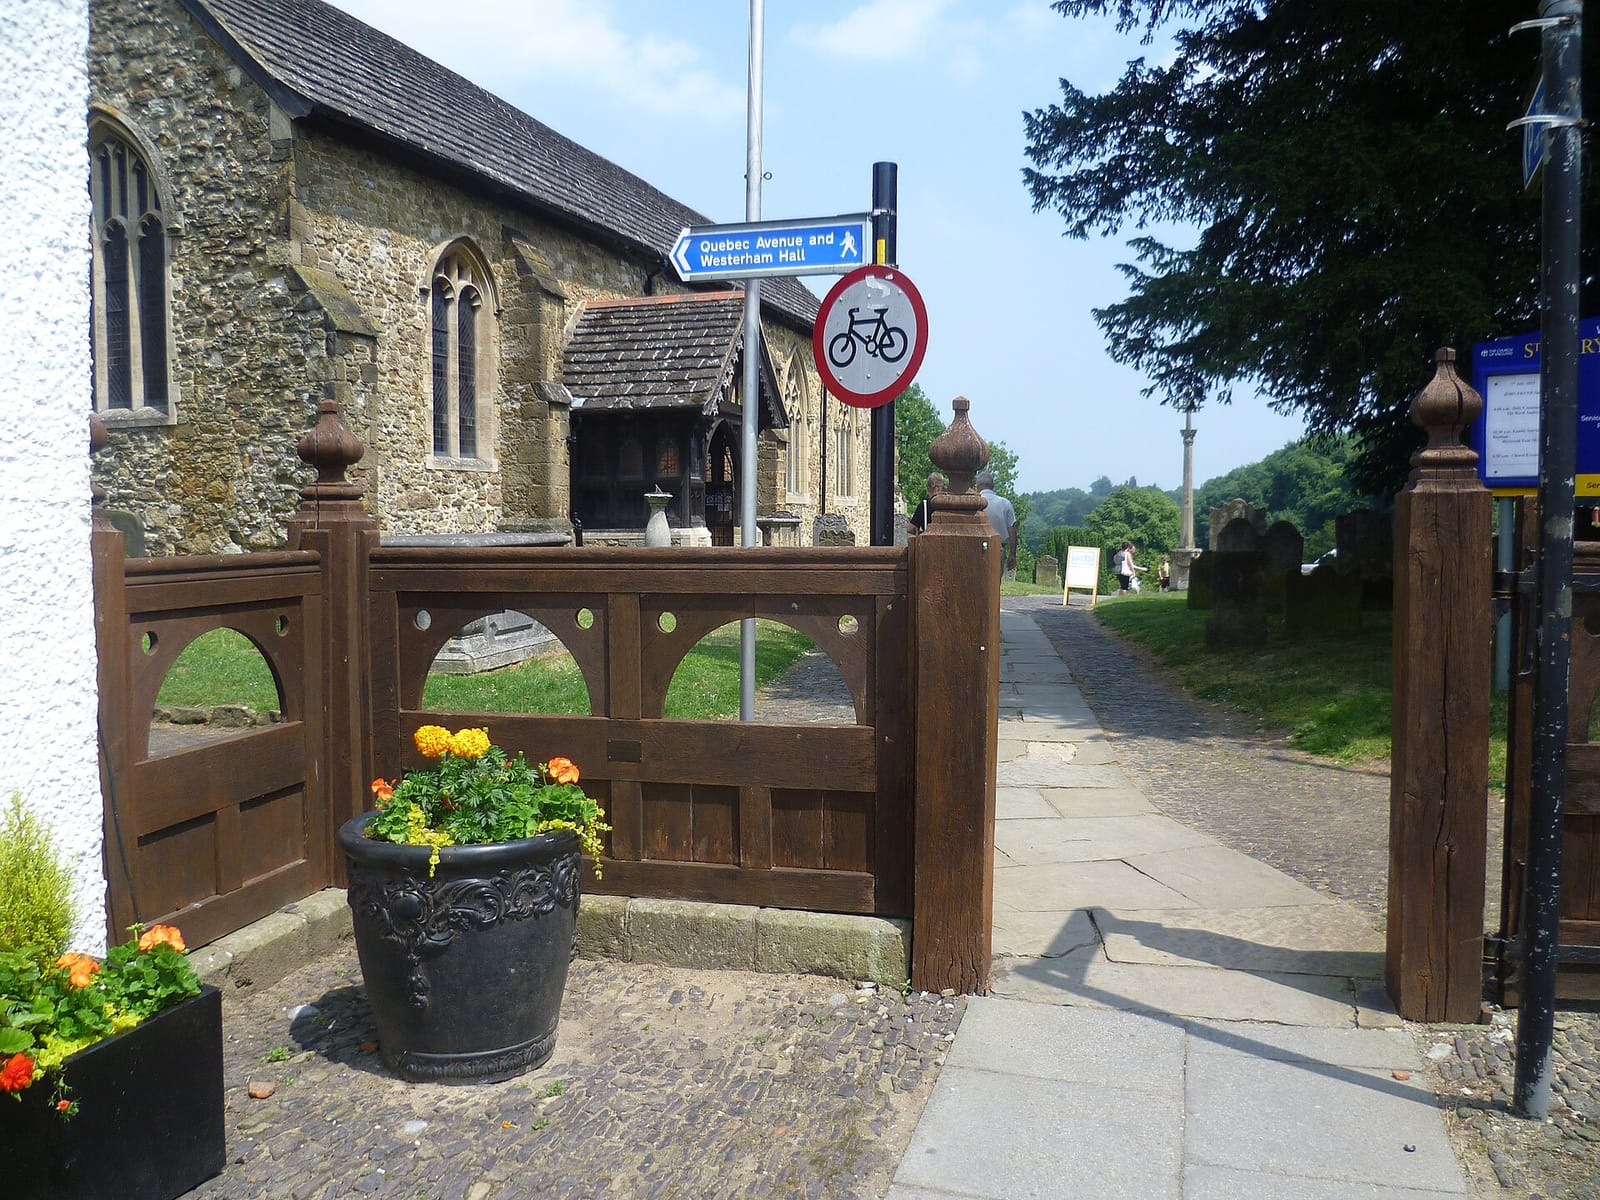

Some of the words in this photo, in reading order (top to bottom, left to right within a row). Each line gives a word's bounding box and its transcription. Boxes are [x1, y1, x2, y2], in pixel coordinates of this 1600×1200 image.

[700, 240, 750, 253] Quebec
[756, 236, 804, 249] Avenue
[809, 232, 834, 246] and
[700, 252, 773, 267] Westerham
[779, 248, 806, 263] Hall
